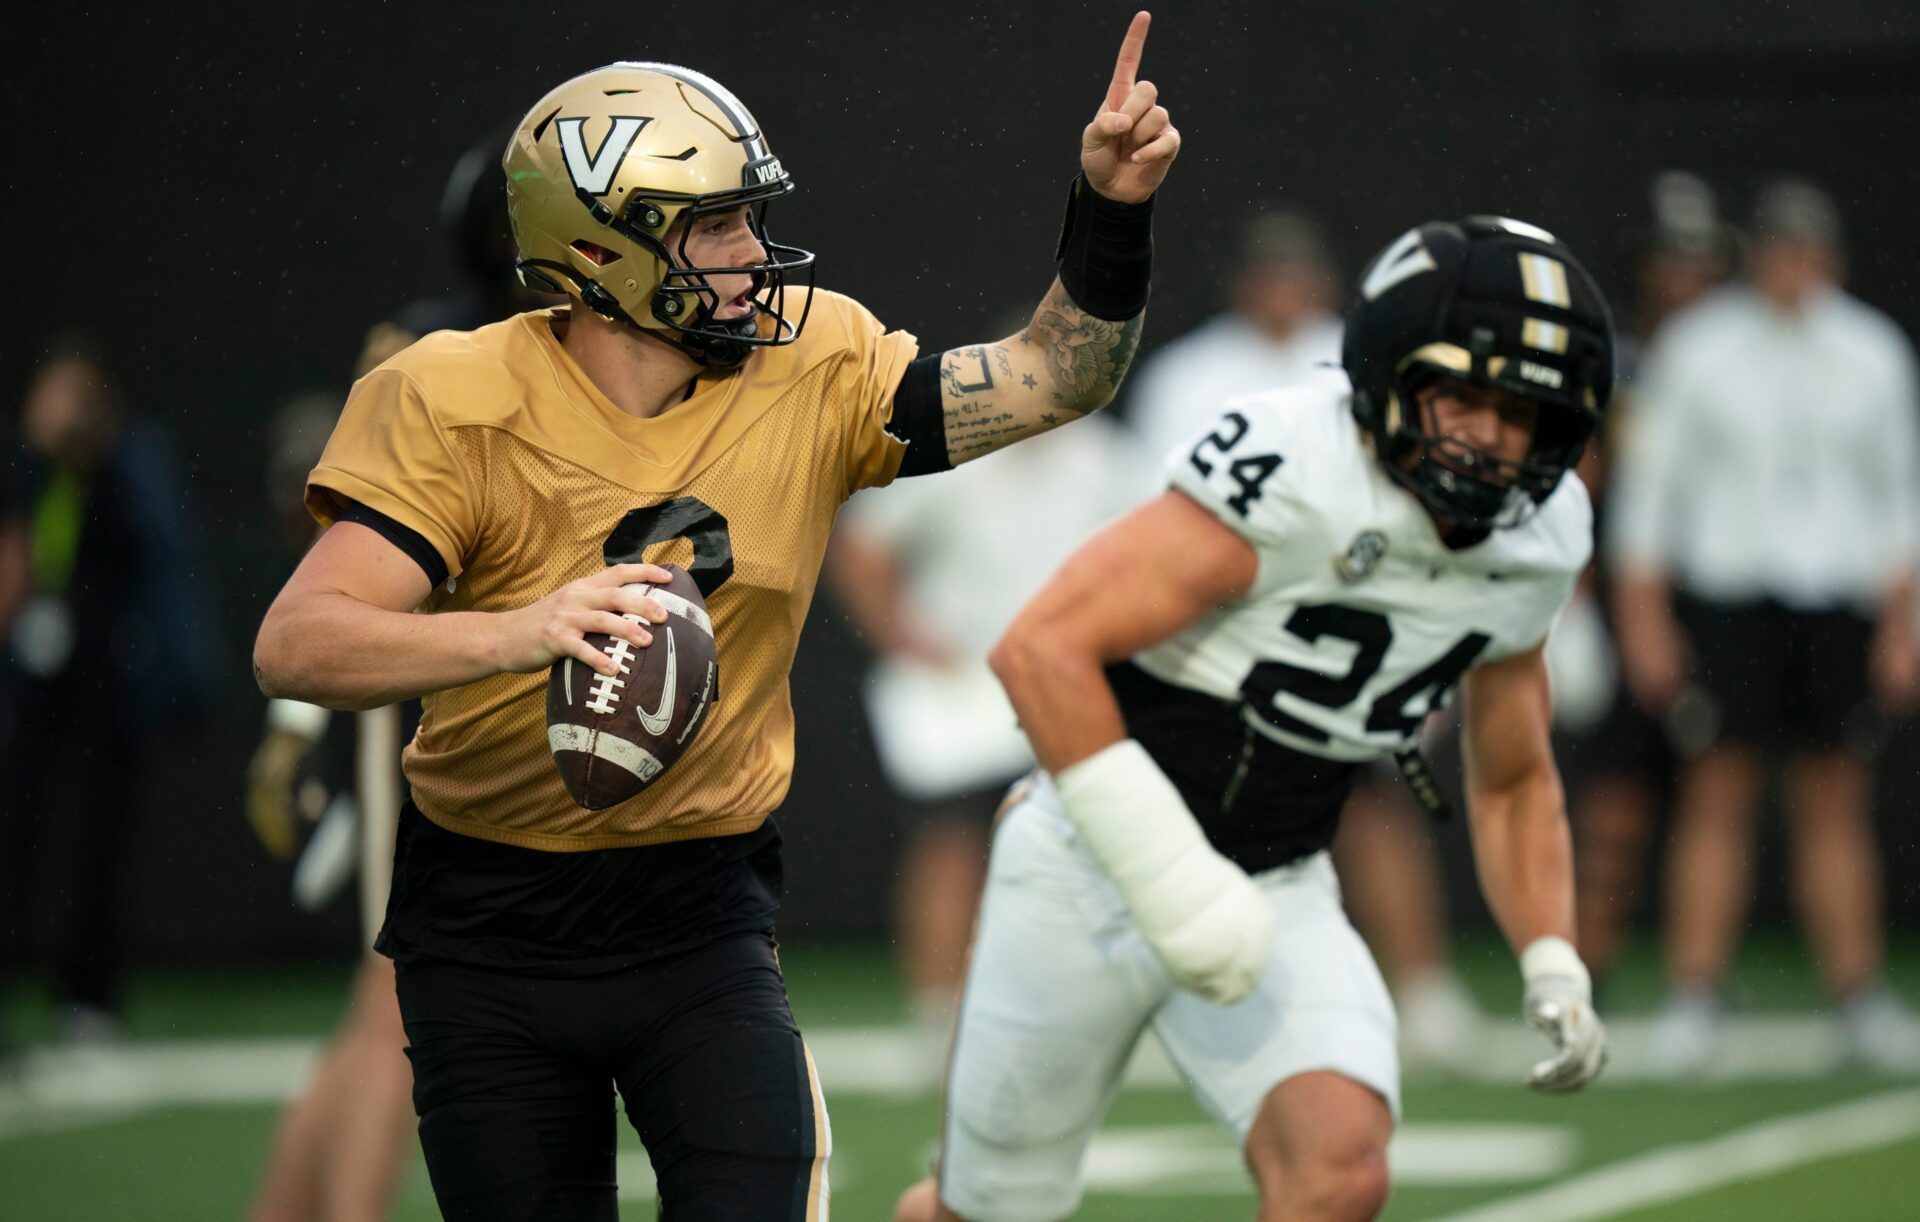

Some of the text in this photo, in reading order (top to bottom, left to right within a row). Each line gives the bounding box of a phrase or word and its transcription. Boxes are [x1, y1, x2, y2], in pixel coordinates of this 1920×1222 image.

[555, 115, 654, 196] V
[1361, 228, 1438, 302] V
[1190, 412, 1284, 518] 24
[1240, 603, 1493, 745] 24
